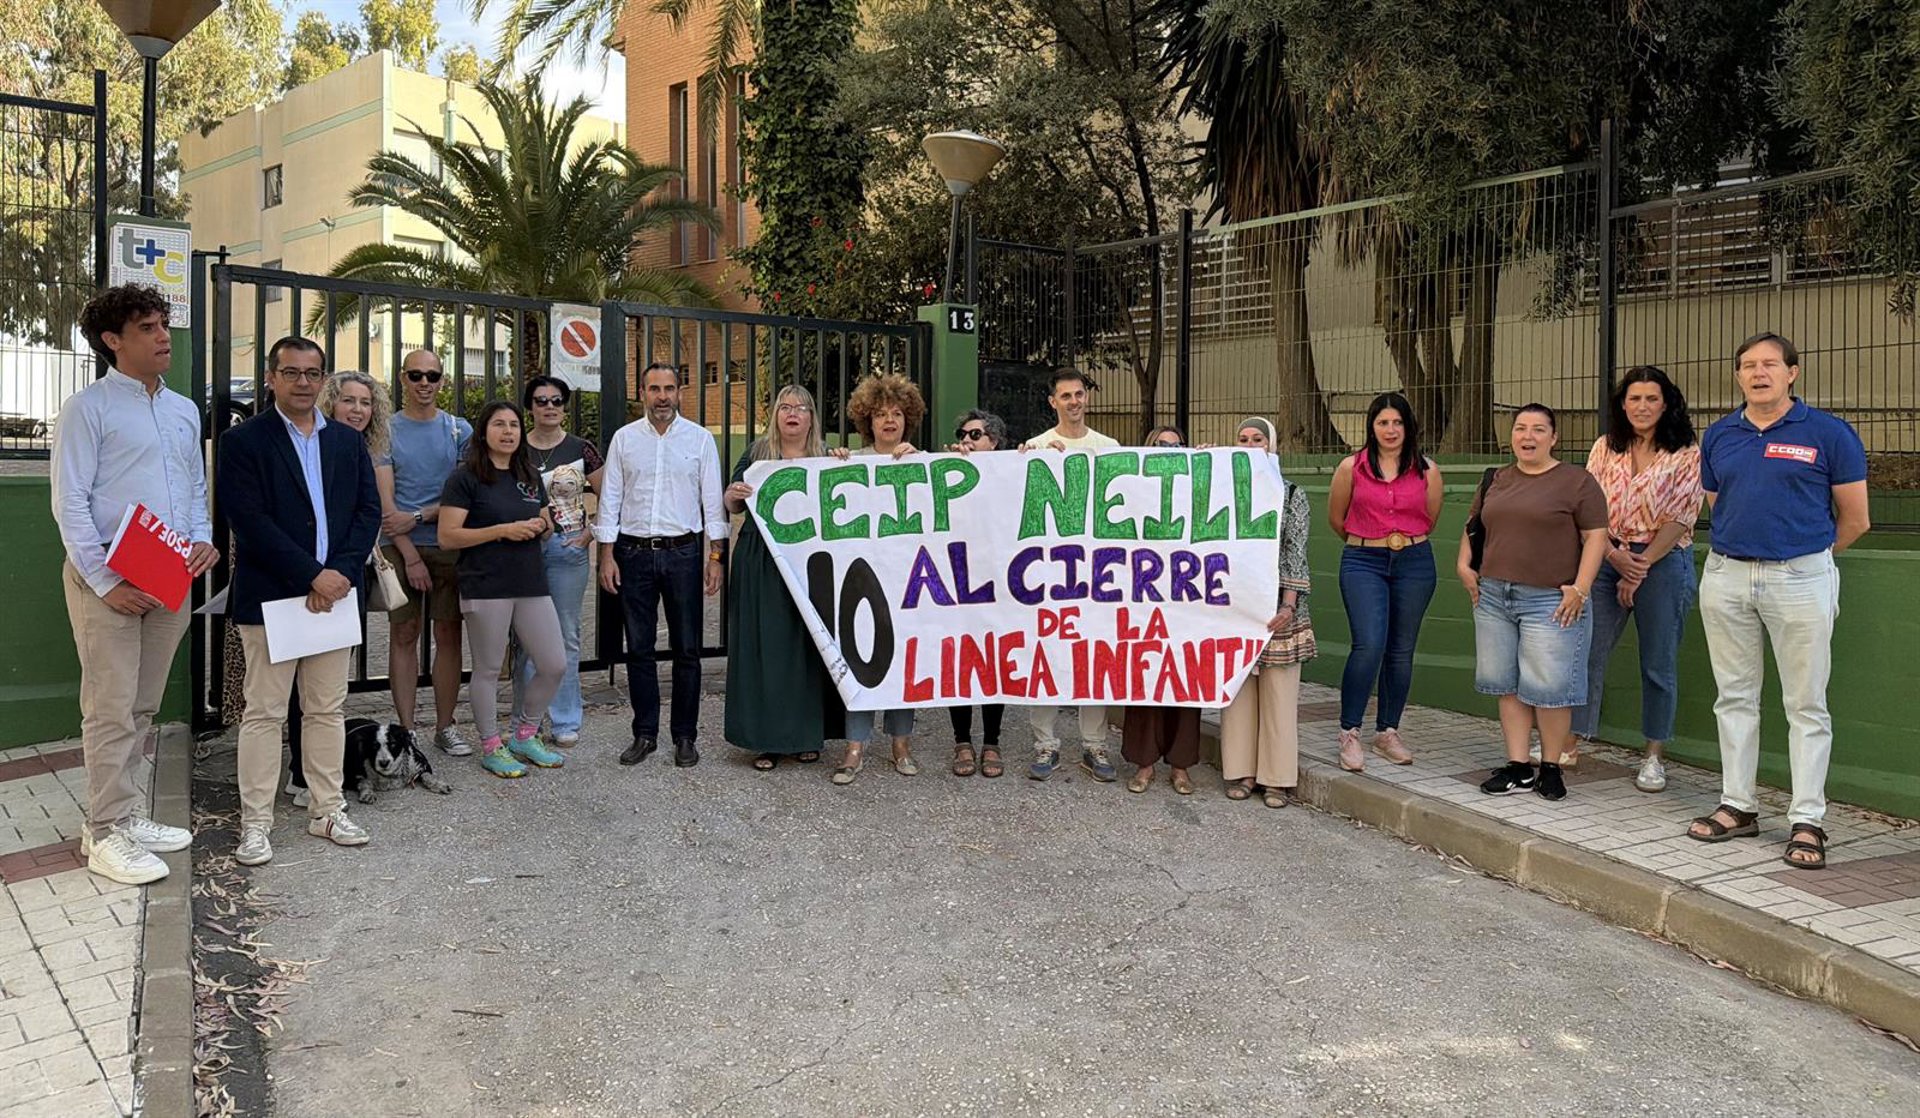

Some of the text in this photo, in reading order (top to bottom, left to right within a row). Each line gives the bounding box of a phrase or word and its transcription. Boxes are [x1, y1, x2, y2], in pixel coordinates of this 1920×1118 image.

[950, 311, 975, 330] 13
[1769, 445, 1804, 455] CCOO
[756, 451, 1278, 544] CEIP NEILL
[157, 523, 193, 559] PSOE
[901, 541, 1231, 609] AL CIERRE
[1037, 605, 1169, 641] DE LA
[903, 630, 1059, 703] LINEA
